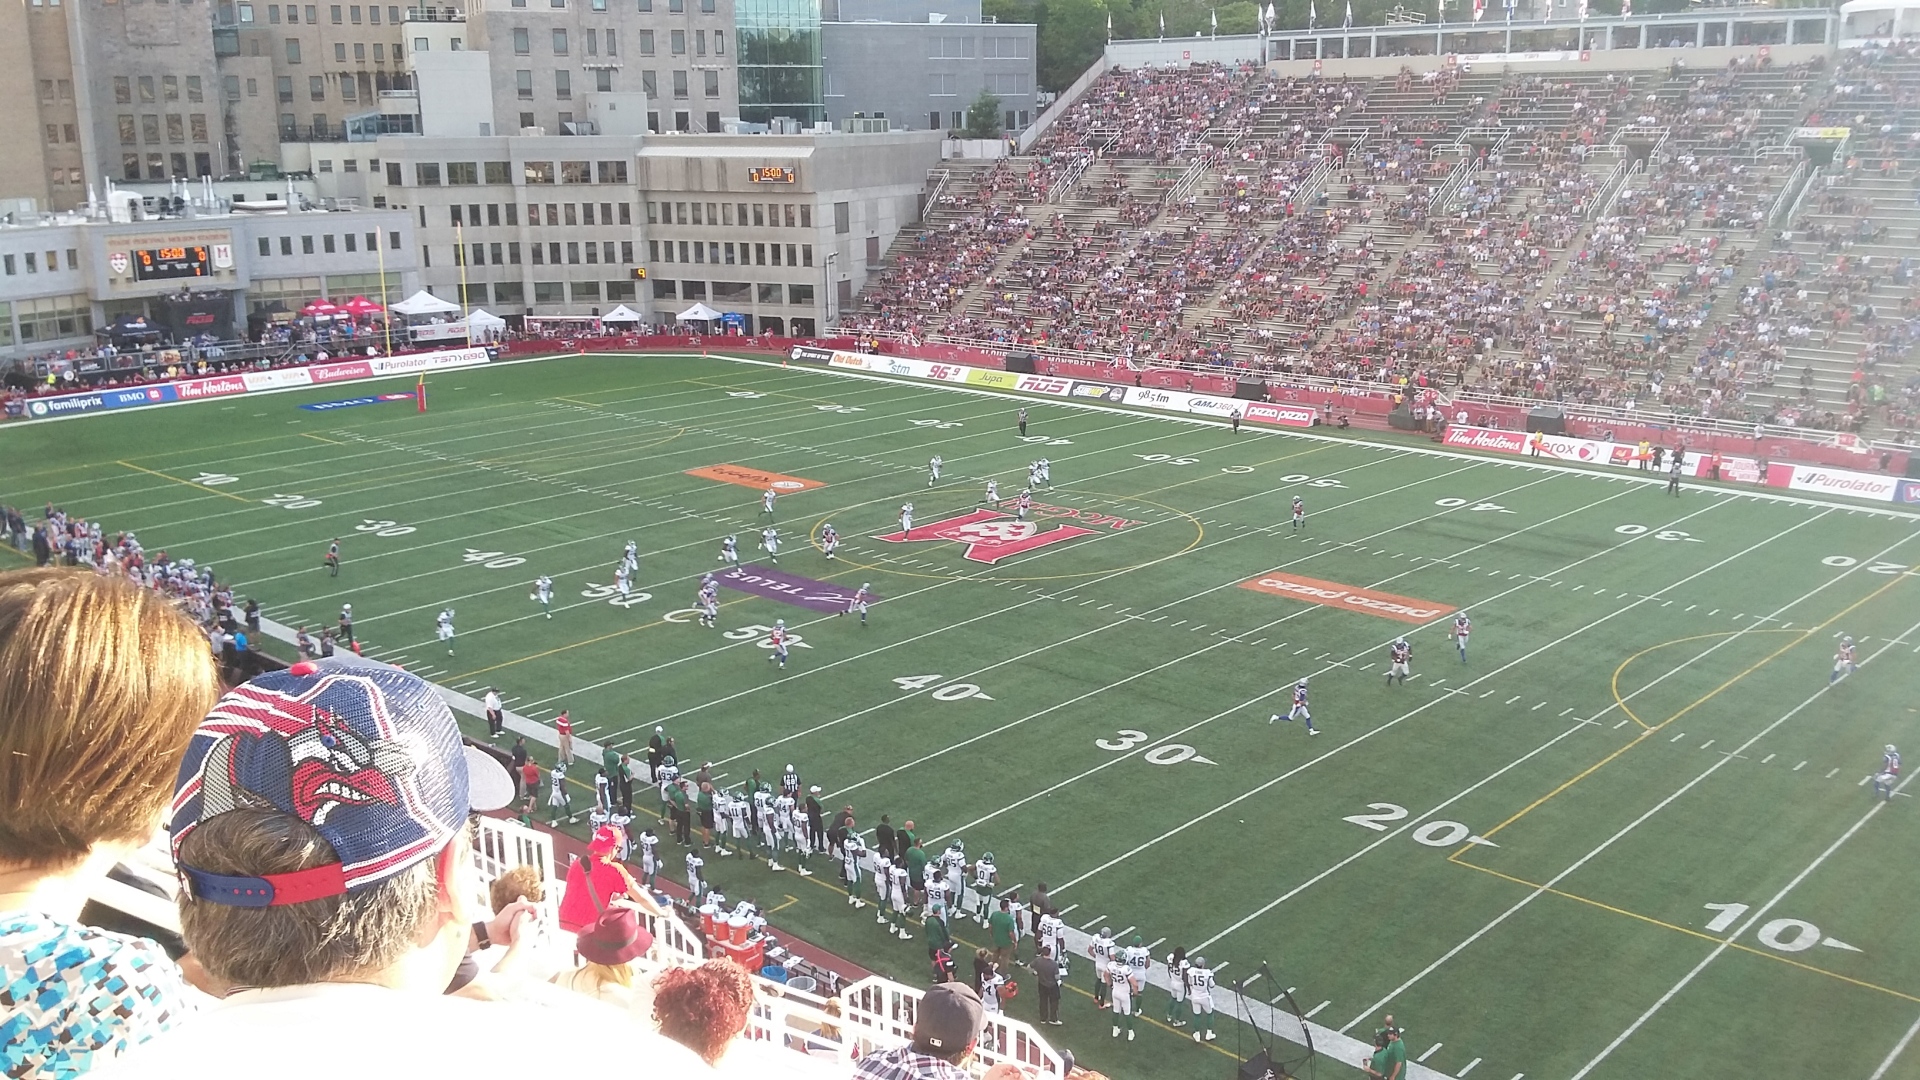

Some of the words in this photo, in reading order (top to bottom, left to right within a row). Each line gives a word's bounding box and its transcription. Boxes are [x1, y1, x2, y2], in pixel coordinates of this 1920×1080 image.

[762, 168, 782, 177] 15:00
[637, 268, 646, 278] 9
[385, 358, 428, 369] Purolator
[834, 354, 846, 363] Old
[845, 356, 863, 365] Dutch
[315, 367, 365, 380] Budweiser
[890, 364, 910, 374] stm
[980, 369, 1003, 384] Jupa
[179, 383, 202, 397] Tim
[202, 380, 244, 394] Hortons
[48, 396, 103, 411] familiprix
[119, 391, 145, 403] BMO
[1247, 407, 1277, 418] pizza
[1277, 410, 1309, 421] pizza
[1448, 428, 1474, 445] Tim
[1475, 432, 1521, 451] Hortons
[1814, 473, 1891, 493] Purolator
[724, 571, 804, 594] TELUS
[1258, 578, 1348, 600] pizza
[1346, 594, 1440, 618] pizza
[892, 674, 981, 701] 40
[1095, 730, 1196, 765] 30
[1342, 802, 1470, 847] 20
[928, 889, 941, 899] 59
[1703, 902, 1821, 952] 10
[1130, 957, 1145, 967] 46
[1111, 974, 1125, 984] 52
[1192, 976, 1205, 987] 15
